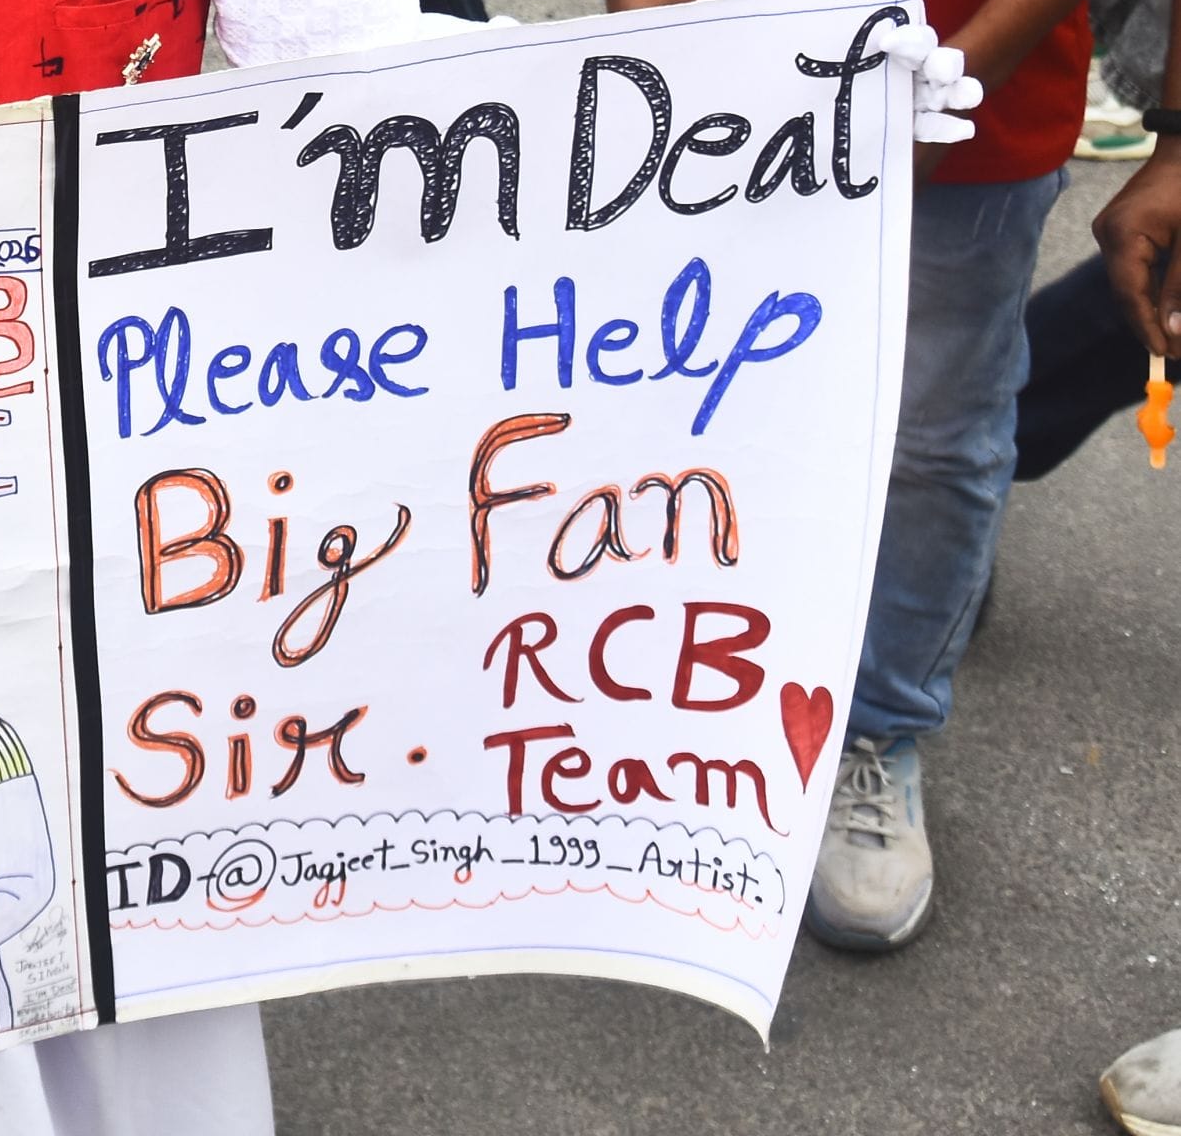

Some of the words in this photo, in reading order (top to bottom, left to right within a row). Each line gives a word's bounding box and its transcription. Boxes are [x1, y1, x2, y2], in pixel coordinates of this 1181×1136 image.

[88, 91, 523, 278] I'm
[565, 5, 909, 232] Deaf
[97, 305, 430, 438] Please
[500, 256, 823, 436] Help
[134, 468, 412, 668] Big
[469, 412, 741, 599] Fan
[482, 601, 772, 712] RCB
[484, 725, 790, 836] Team
